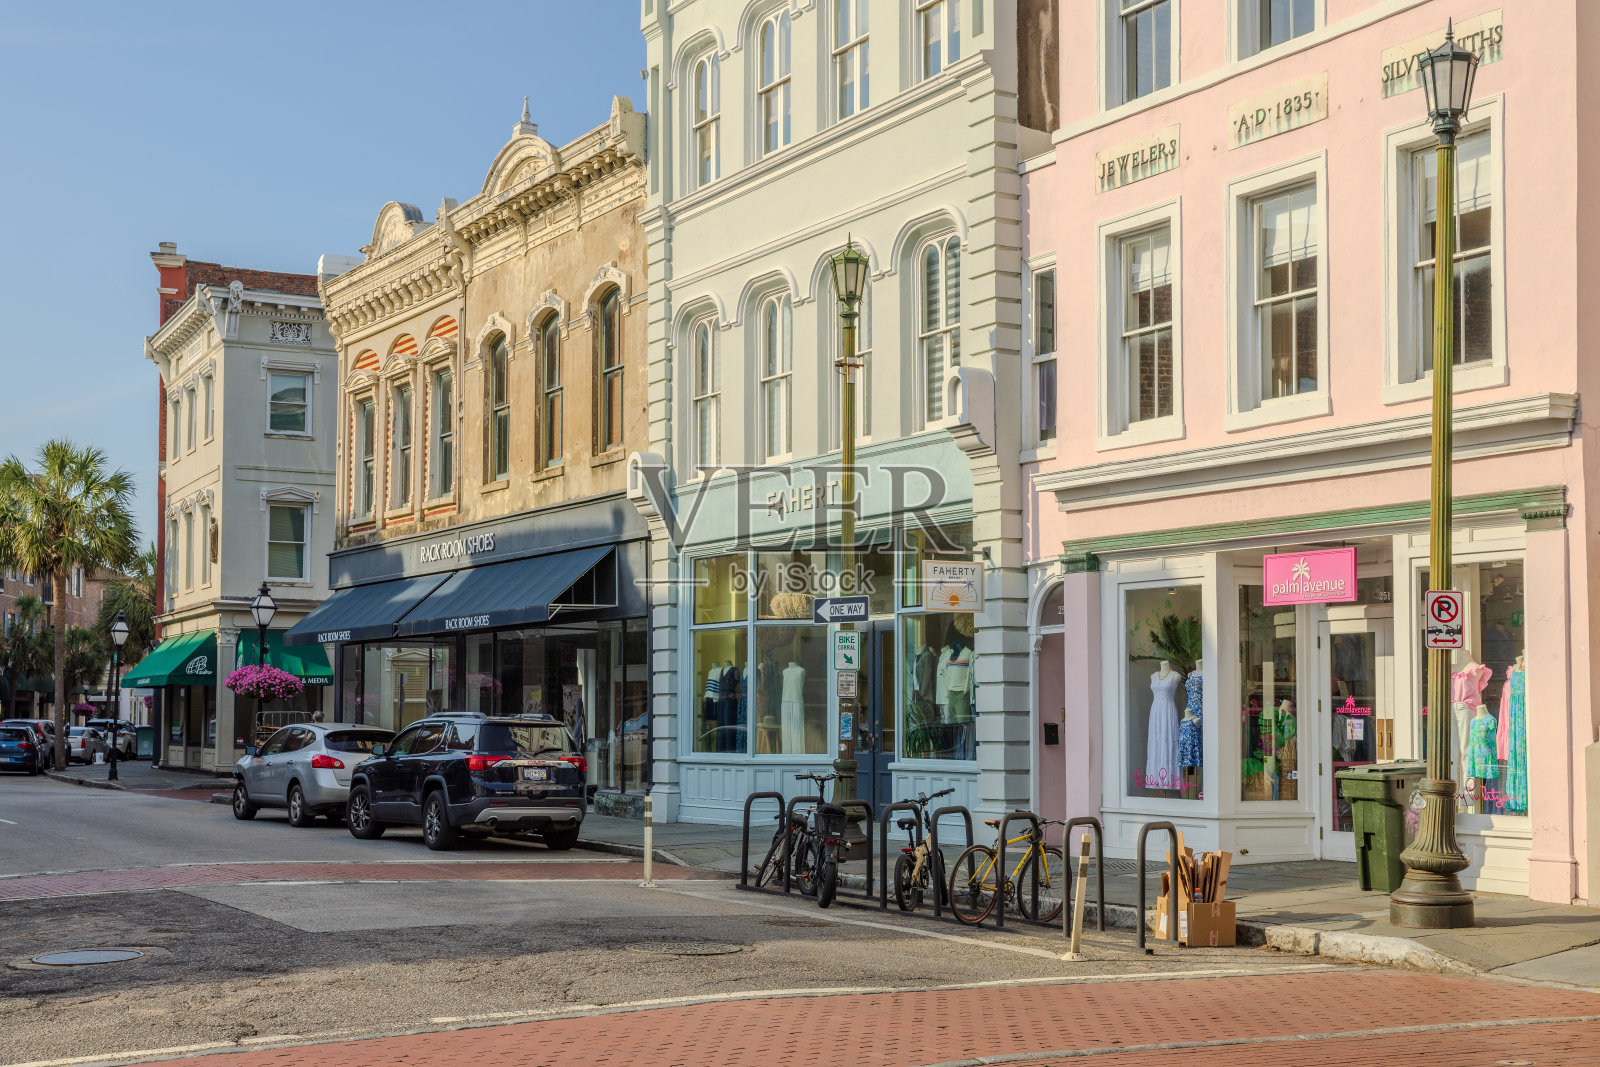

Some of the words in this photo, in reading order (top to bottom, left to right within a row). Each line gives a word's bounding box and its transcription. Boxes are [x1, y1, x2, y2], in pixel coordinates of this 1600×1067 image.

[1098, 138, 1177, 180] JEWELERS
[766, 480, 843, 517] FAHERT
[420, 544, 441, 563] RACK
[441, 539, 467, 560] ROOM
[467, 533, 495, 555] SHOES
[933, 566, 976, 576] FAHERTY
[1272, 579, 1300, 598] palm
[1303, 579, 1345, 592] avenue
[829, 605, 845, 616] ONE
[847, 604, 863, 615] WAY
[445, 619, 458, 629] RACK
[458, 617, 473, 628] ROOM
[473, 615, 490, 627] SHOES
[838, 635, 856, 644] BIKE
